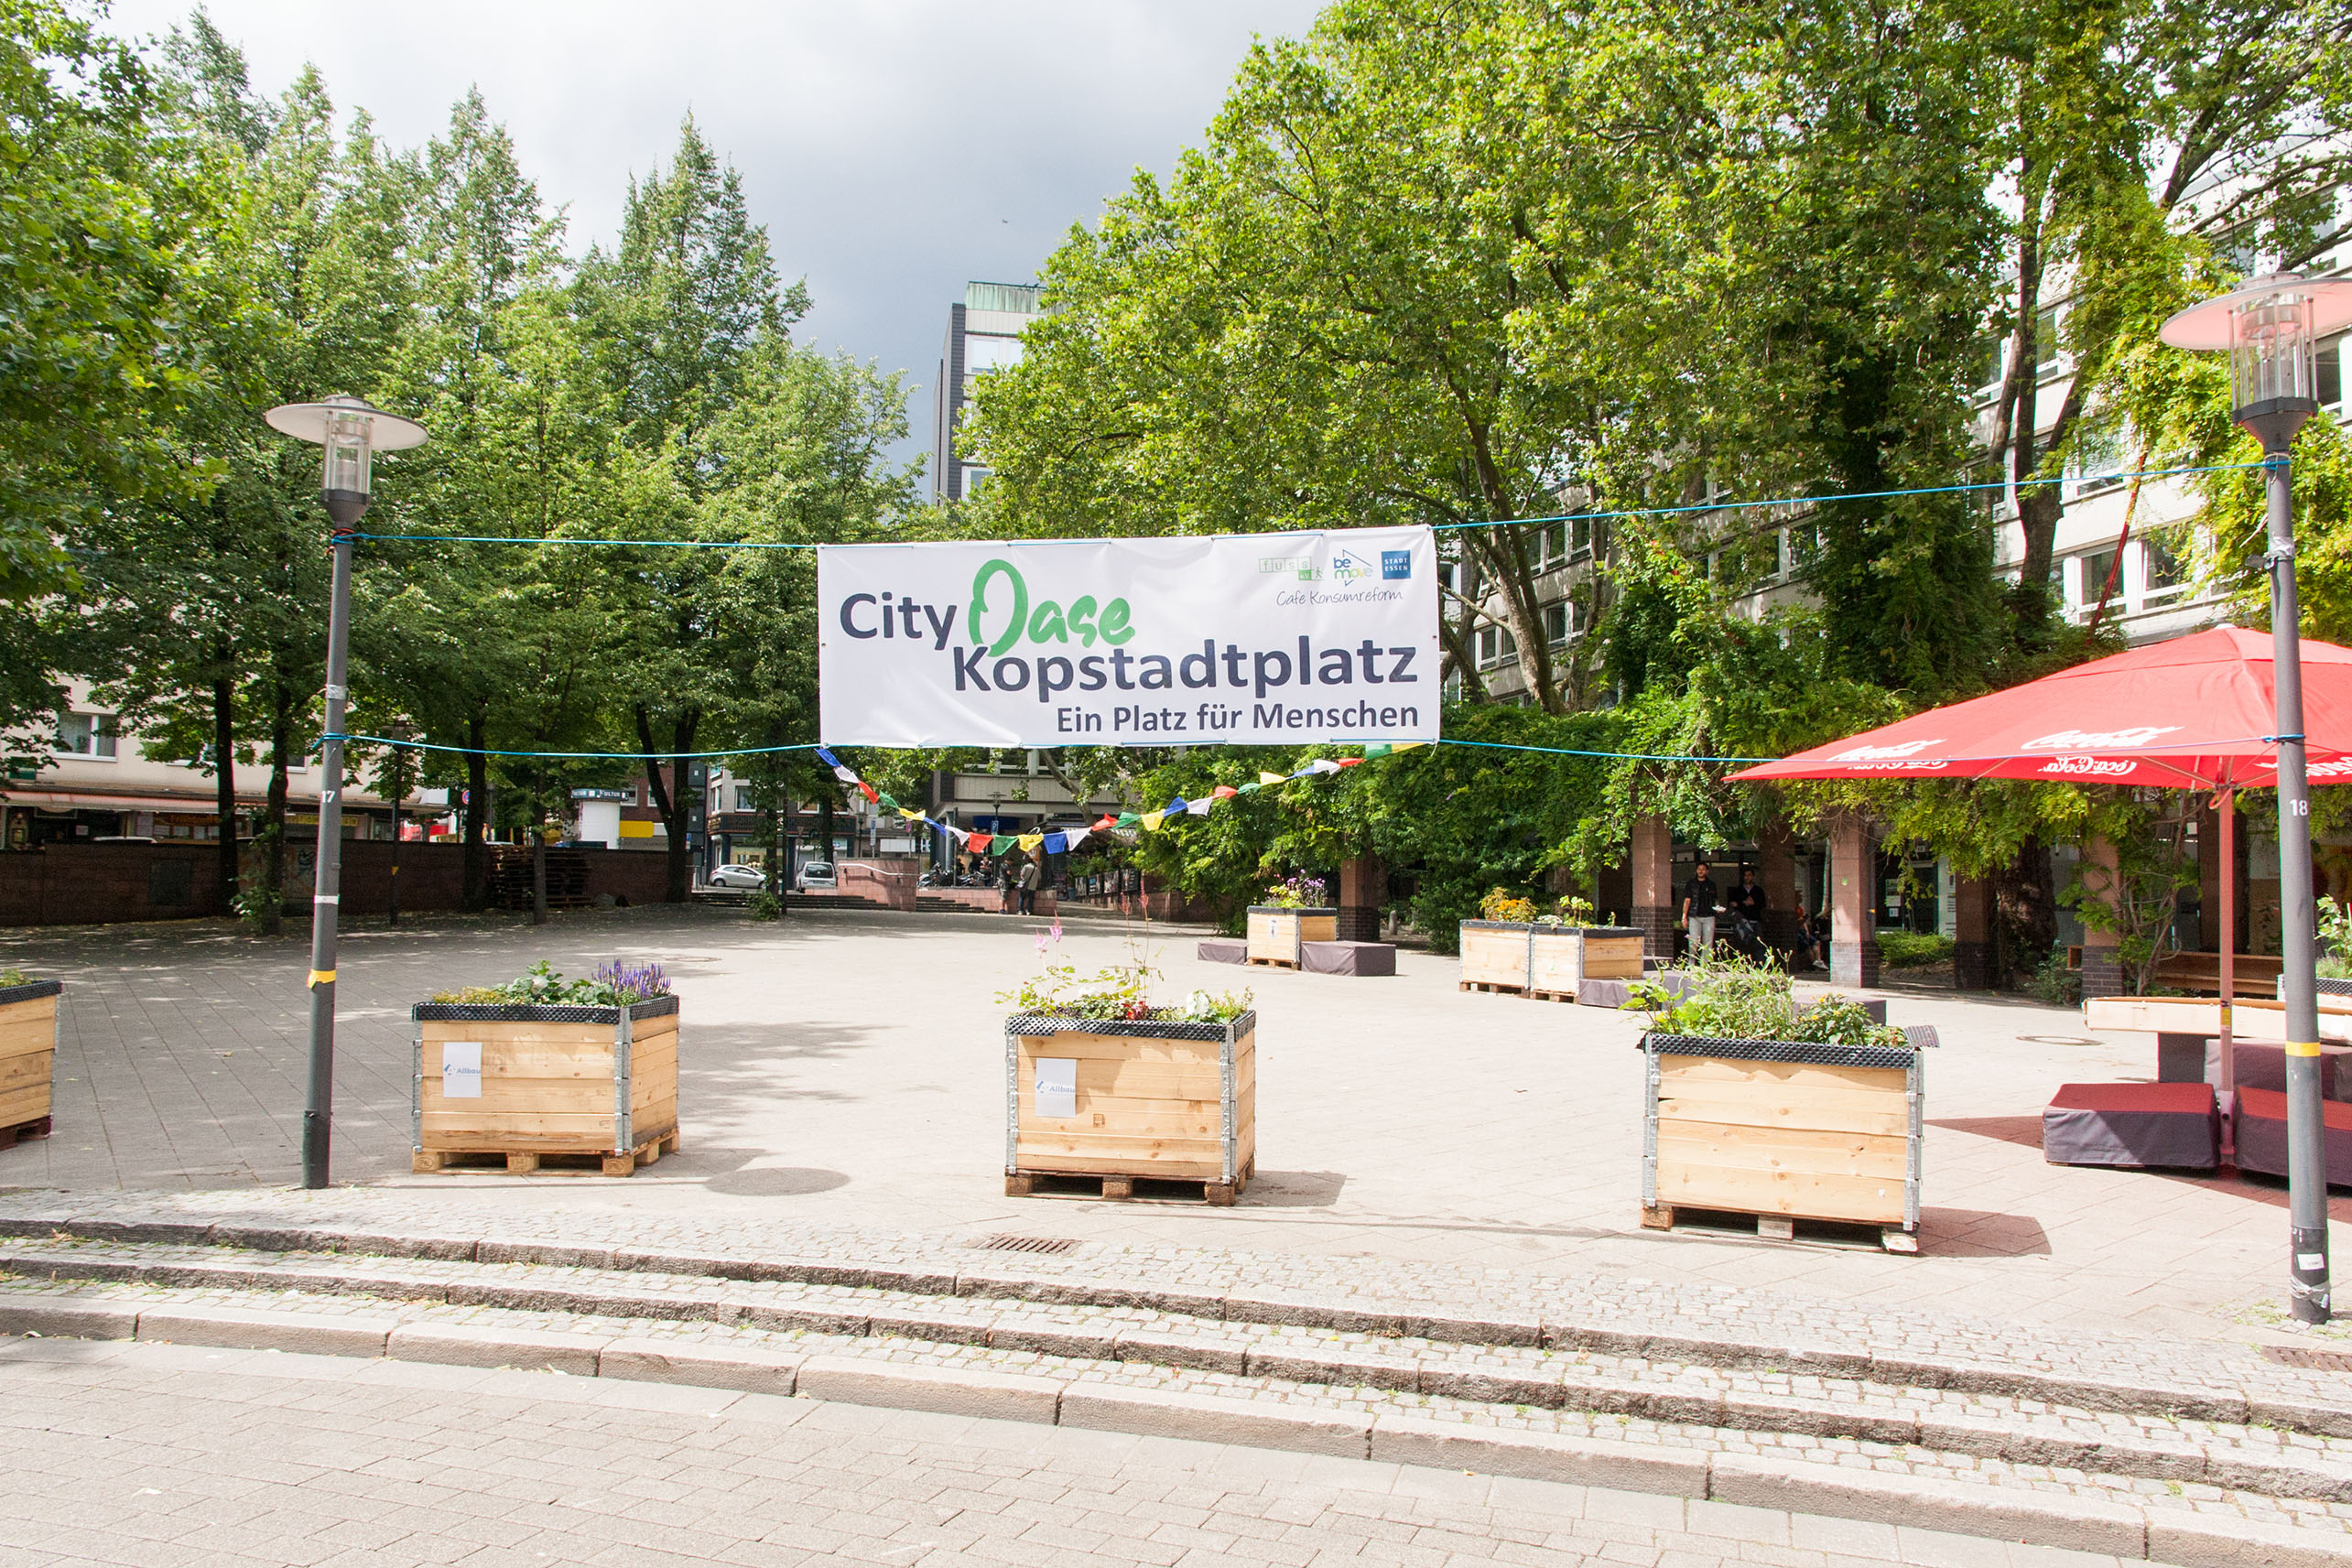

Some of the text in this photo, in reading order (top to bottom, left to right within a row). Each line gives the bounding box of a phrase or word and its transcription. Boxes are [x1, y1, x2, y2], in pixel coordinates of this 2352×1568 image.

[1263, 559, 1309, 571] fuss
[1333, 557, 1351, 568] be
[1334, 568, 1373, 579] move
[1276, 587, 1404, 606] Cafe Konsumreform
[840, 558, 1135, 657] City Oase
[953, 634, 1418, 703] Kopstadtplatz
[1057, 699, 1418, 732] Ein Platz für Menschen
[321, 790, 336, 804] 17
[2290, 799, 2308, 816] 18
